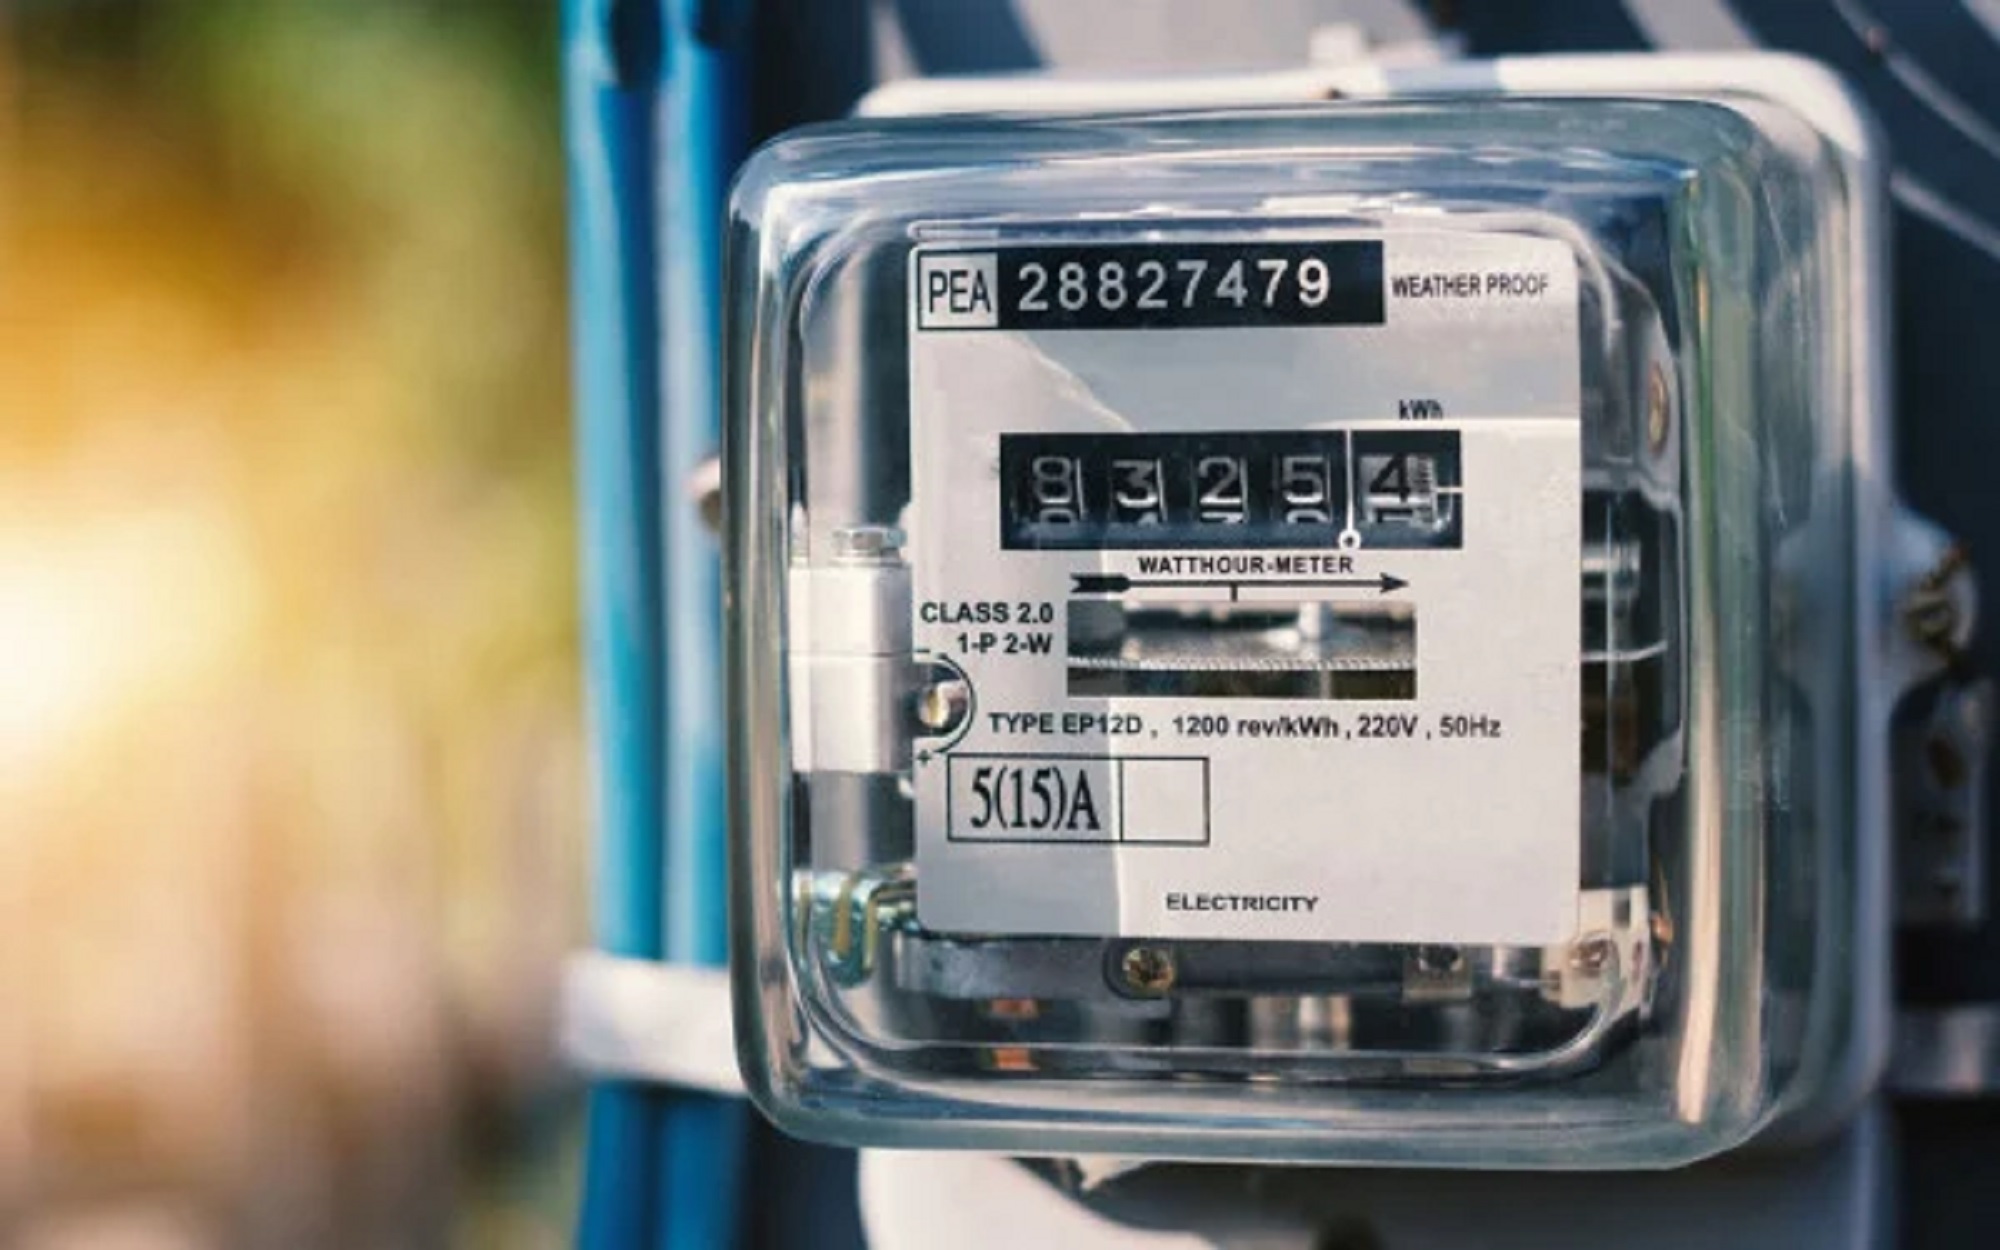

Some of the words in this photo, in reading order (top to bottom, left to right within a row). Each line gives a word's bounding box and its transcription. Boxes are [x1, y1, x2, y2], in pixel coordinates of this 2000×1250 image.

[926, 268, 992, 312] PEA
[1018, 258, 1330, 312] 28827479
[1391, 274, 1482, 298] WEATHER
[1487, 271, 1549, 296] PROOF
[1399, 399, 1443, 420] kWh
[1138, 555, 1354, 576] WATTHOUR-METER
[920, 602, 1010, 624] CLASS
[1018, 602, 1054, 625] 2.0
[957, 634, 998, 653] 1-P
[1004, 633, 1052, 656] 2-W
[988, 711, 1054, 735] TYPE
[1173, 715, 1230, 737] 1200
[1440, 716, 1501, 739] 50Hz
[971, 767, 1100, 831] 5(15)A
[1165, 892, 1319, 913] ELECTRICITY
